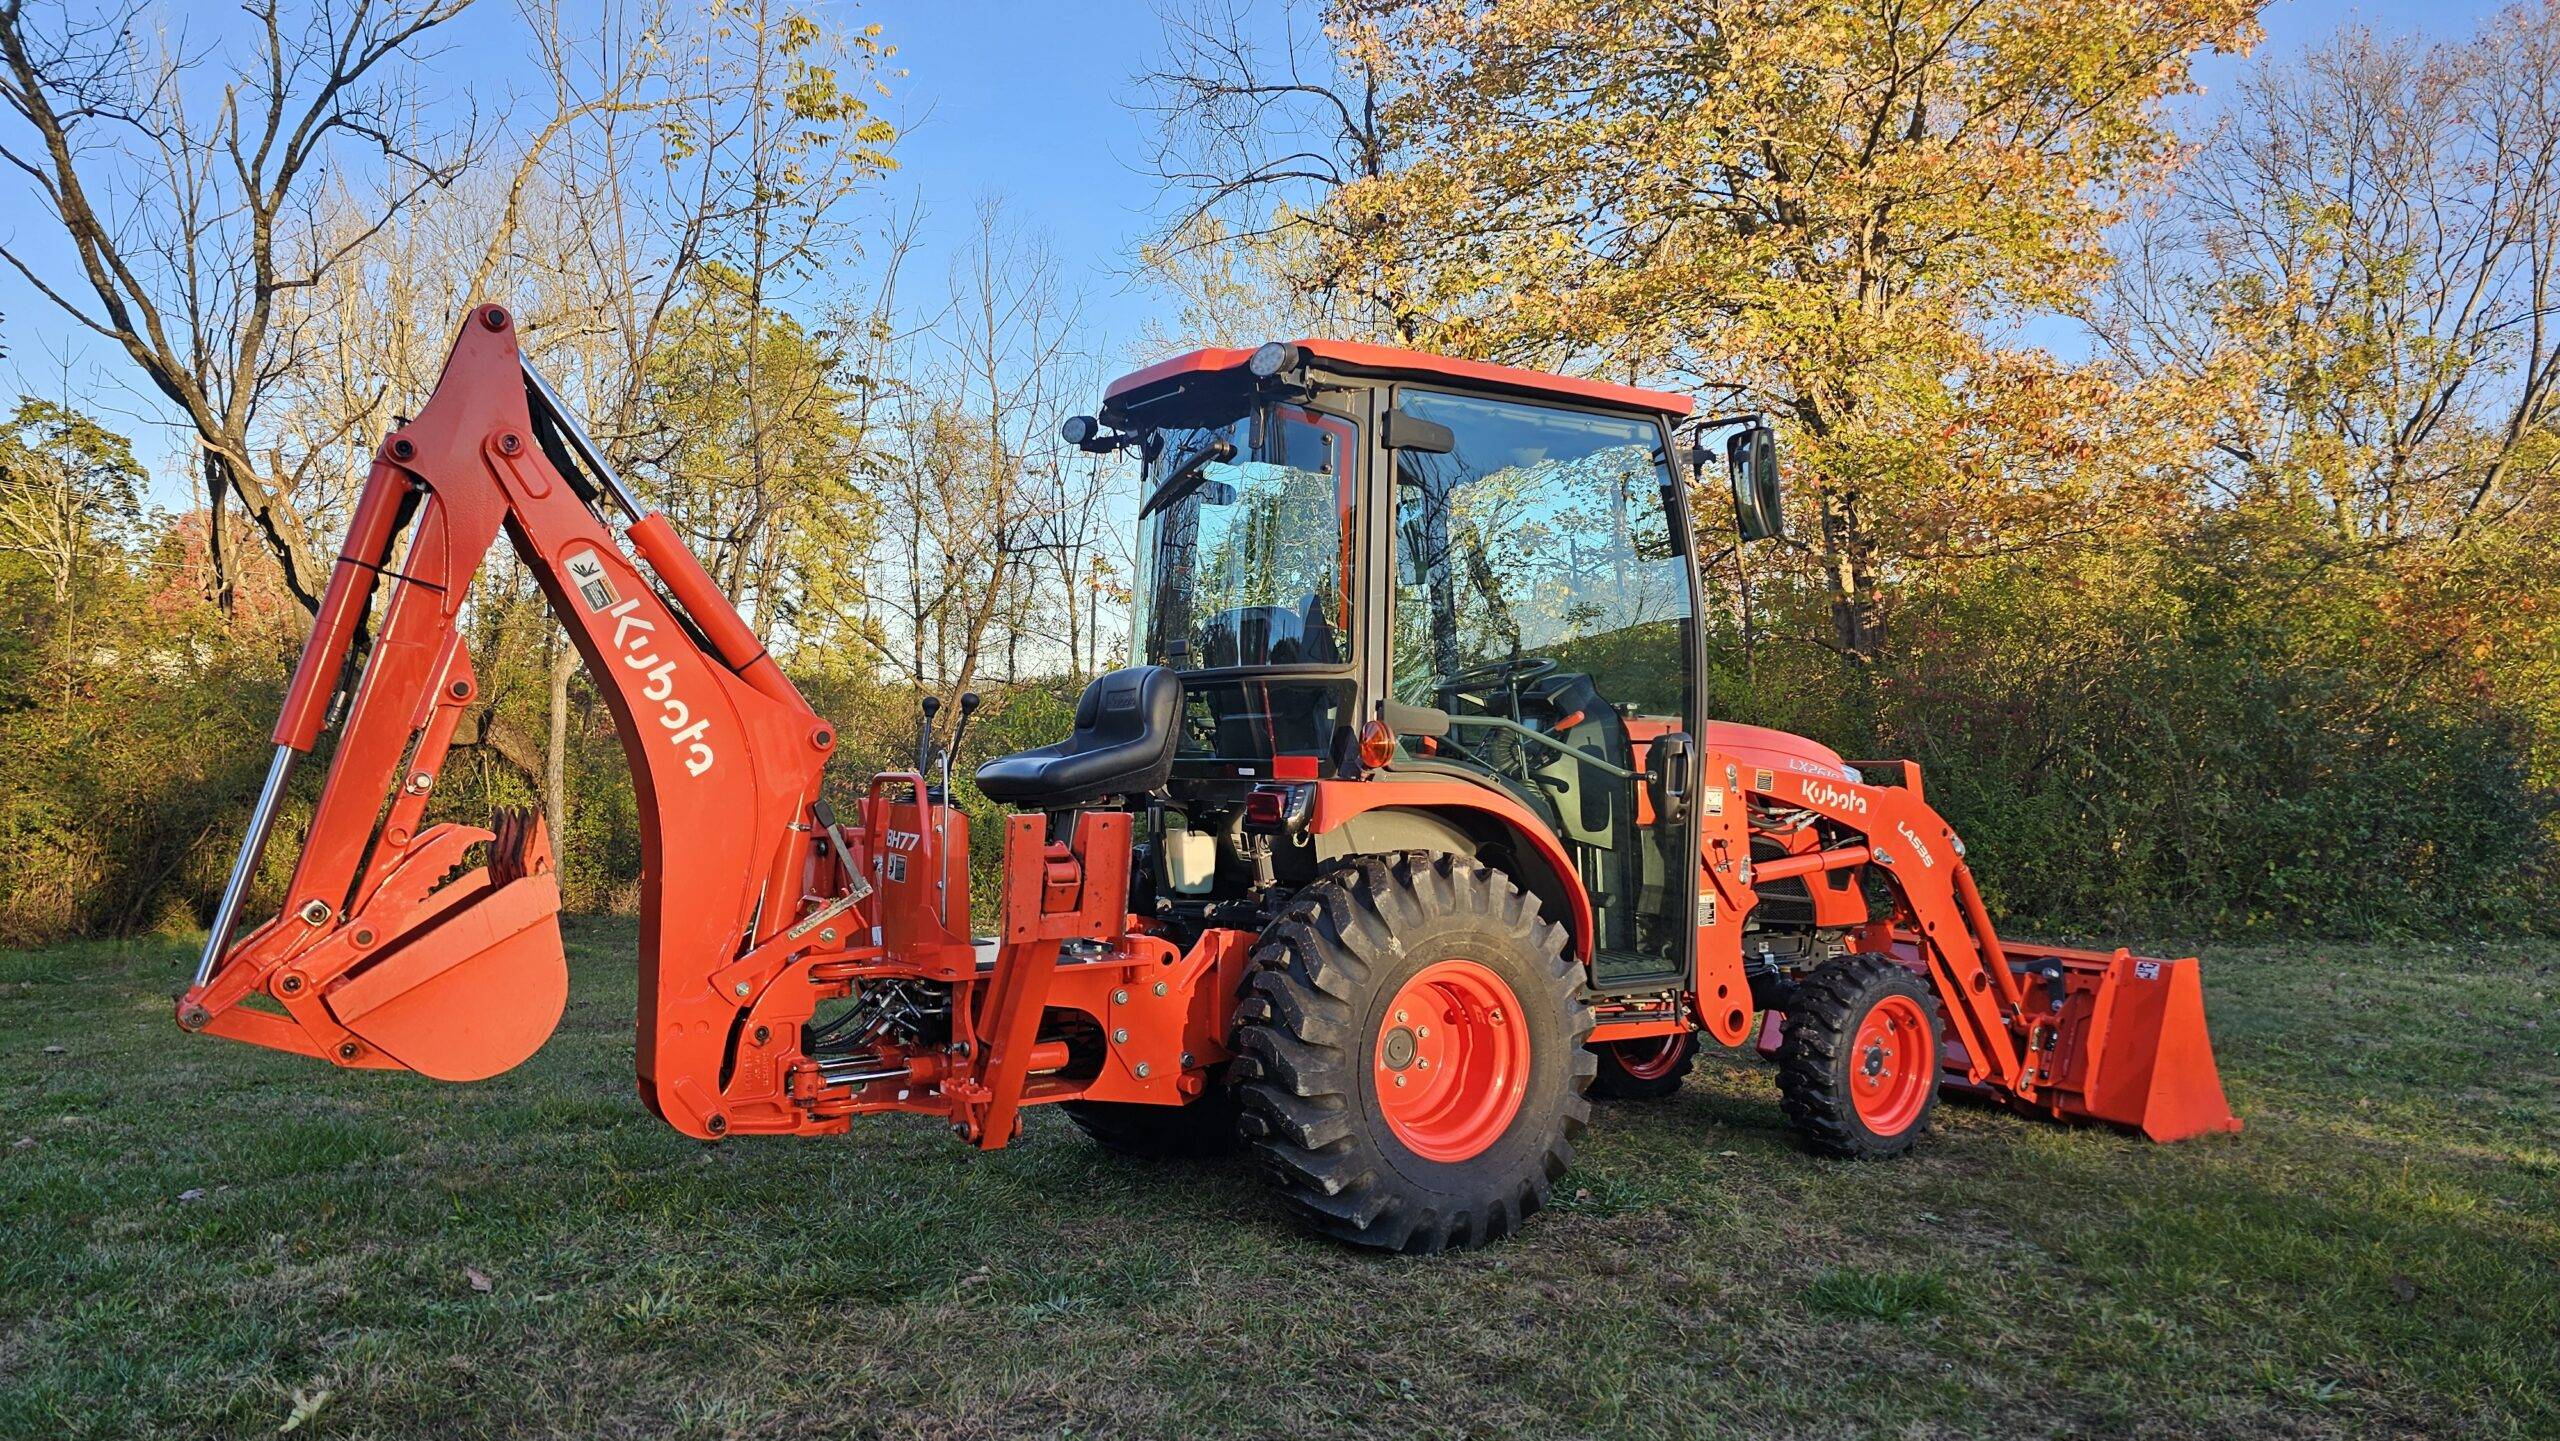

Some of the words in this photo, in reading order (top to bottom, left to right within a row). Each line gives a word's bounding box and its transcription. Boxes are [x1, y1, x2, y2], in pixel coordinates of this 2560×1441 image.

[610, 598, 714, 778] Kubota
[1801, 779, 1867, 814] Kubota
[886, 829, 920, 851] BH77
